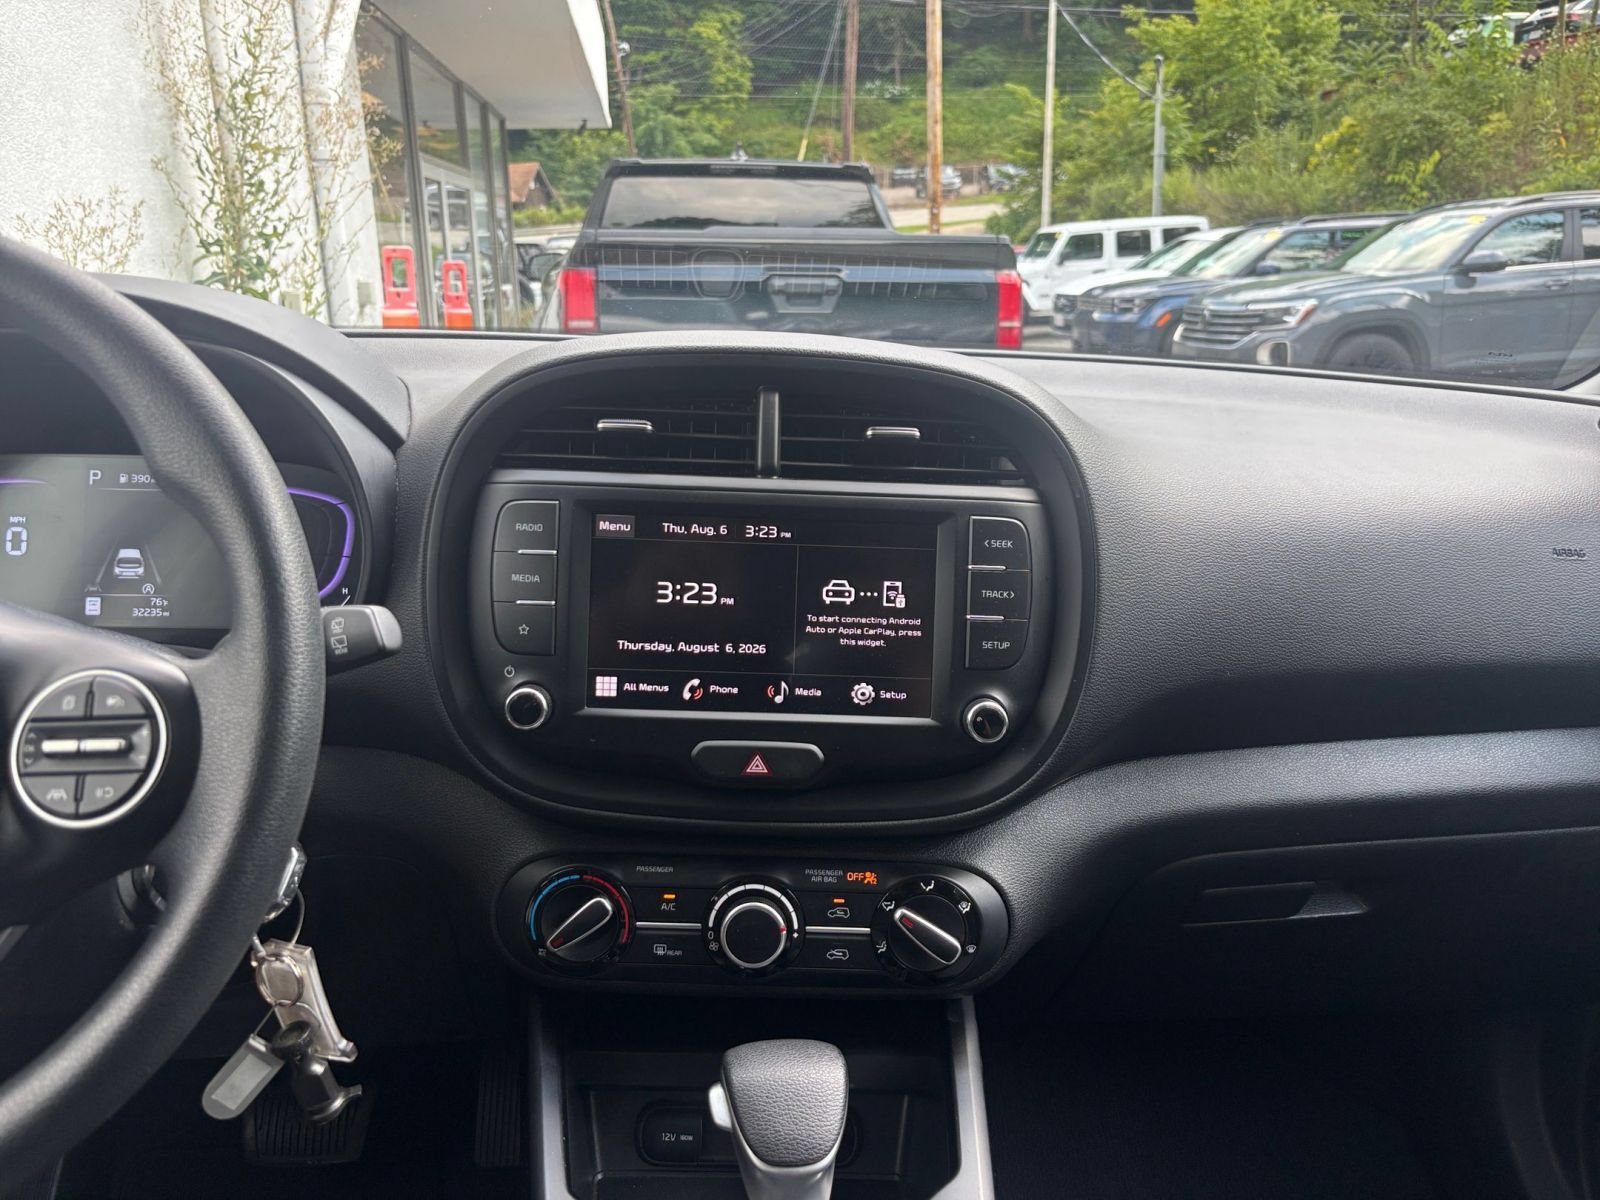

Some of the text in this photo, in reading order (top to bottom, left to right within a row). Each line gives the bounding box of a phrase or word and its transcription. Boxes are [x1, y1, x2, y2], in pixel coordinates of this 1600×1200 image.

[89, 470, 102, 486] P
[516, 523, 543, 532] RADIO
[600, 521, 630, 532] Menu
[690, 524, 716, 536] Aug.
[720, 524, 728, 535] 6
[746, 526, 778, 538] 3:23
[6, 526, 28, 556] 0
[991, 540, 1014, 548] SEEK
[1552, 547, 1586, 558] AIRBAG
[512, 574, 540, 582] MEDIA
[342, 587, 349, 595] H
[656, 581, 734, 605] 3:23 PM
[982, 590, 1009, 599] TRACK
[807, 614, 921, 626] To start connecting Android
[806, 626, 826, 634] Auto
[838, 626, 862, 636] Apple
[898, 630, 922, 638] press
[617, 640, 675, 653] Thursday,
[678, 642, 720, 654] August
[738, 644, 766, 654] 2026
[840, 638, 886, 648] this widget.
[982, 641, 1010, 650] SETUP
[624, 682, 670, 692] All Menus
[710, 685, 739, 694] Phone
[795, 688, 822, 697] Media
[880, 690, 907, 700] Setup
[805, 868, 844, 877] PASSENGER
[846, 872, 865, 882] OFF
[661, 902, 676, 912] A/C
[662, 1132, 676, 1142] 12V
